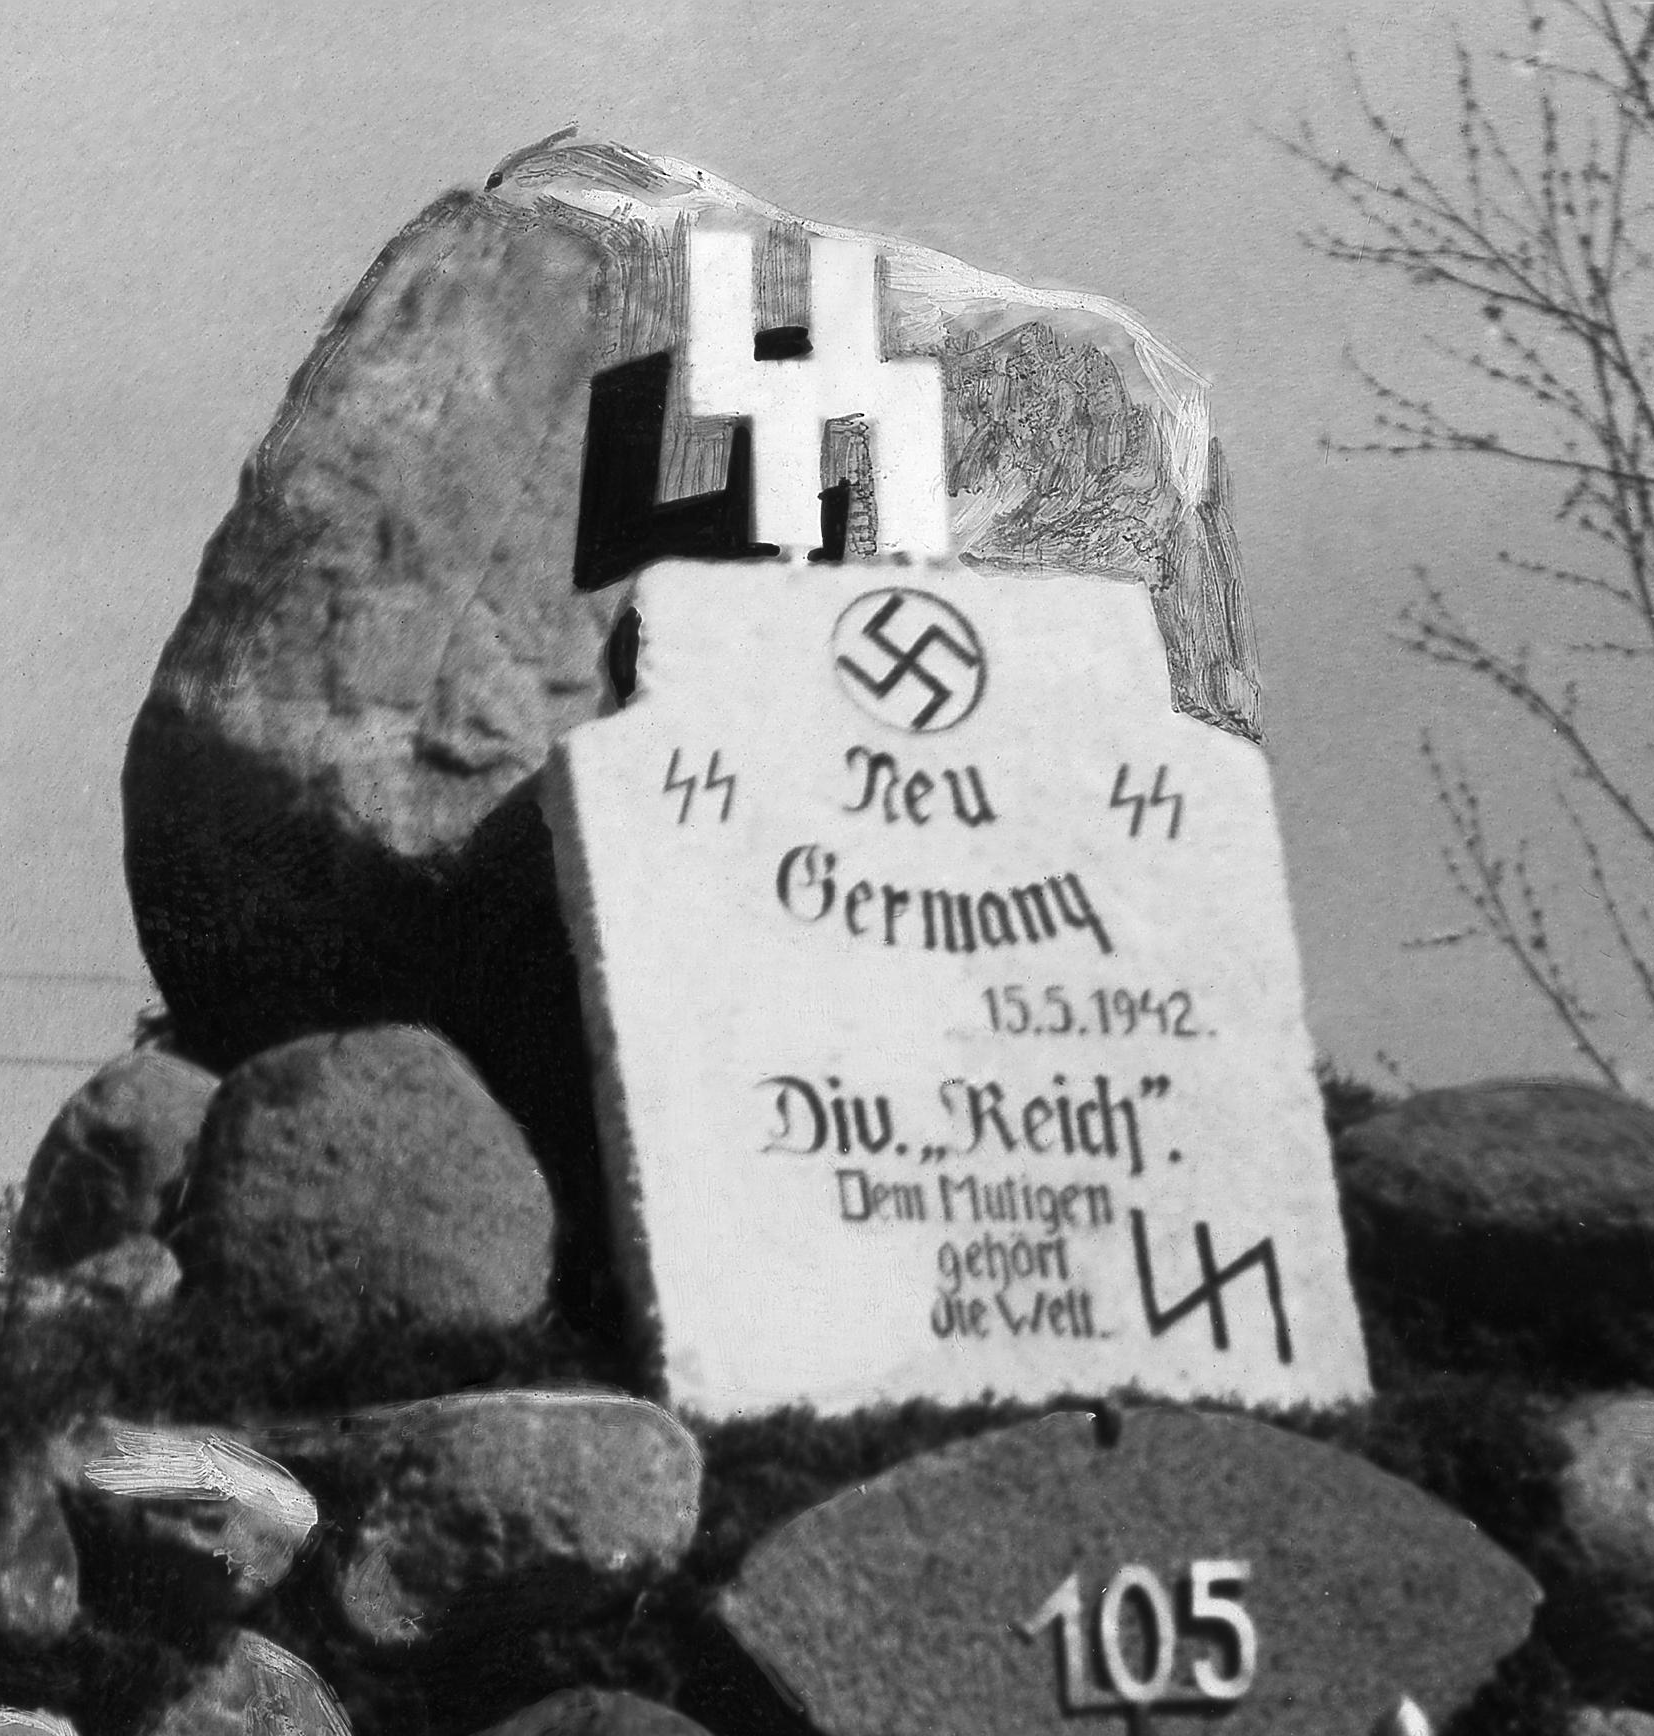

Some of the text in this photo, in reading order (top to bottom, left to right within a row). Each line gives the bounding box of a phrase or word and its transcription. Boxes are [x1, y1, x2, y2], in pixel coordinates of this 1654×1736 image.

[842, 744, 999, 828] Neu
[774, 842, 1115, 956] Germany
[836, 1169, 1114, 1235] Dem Mutigen
[930, 1290, 990, 1340] die
[1022, 1558, 1259, 1706] 105
